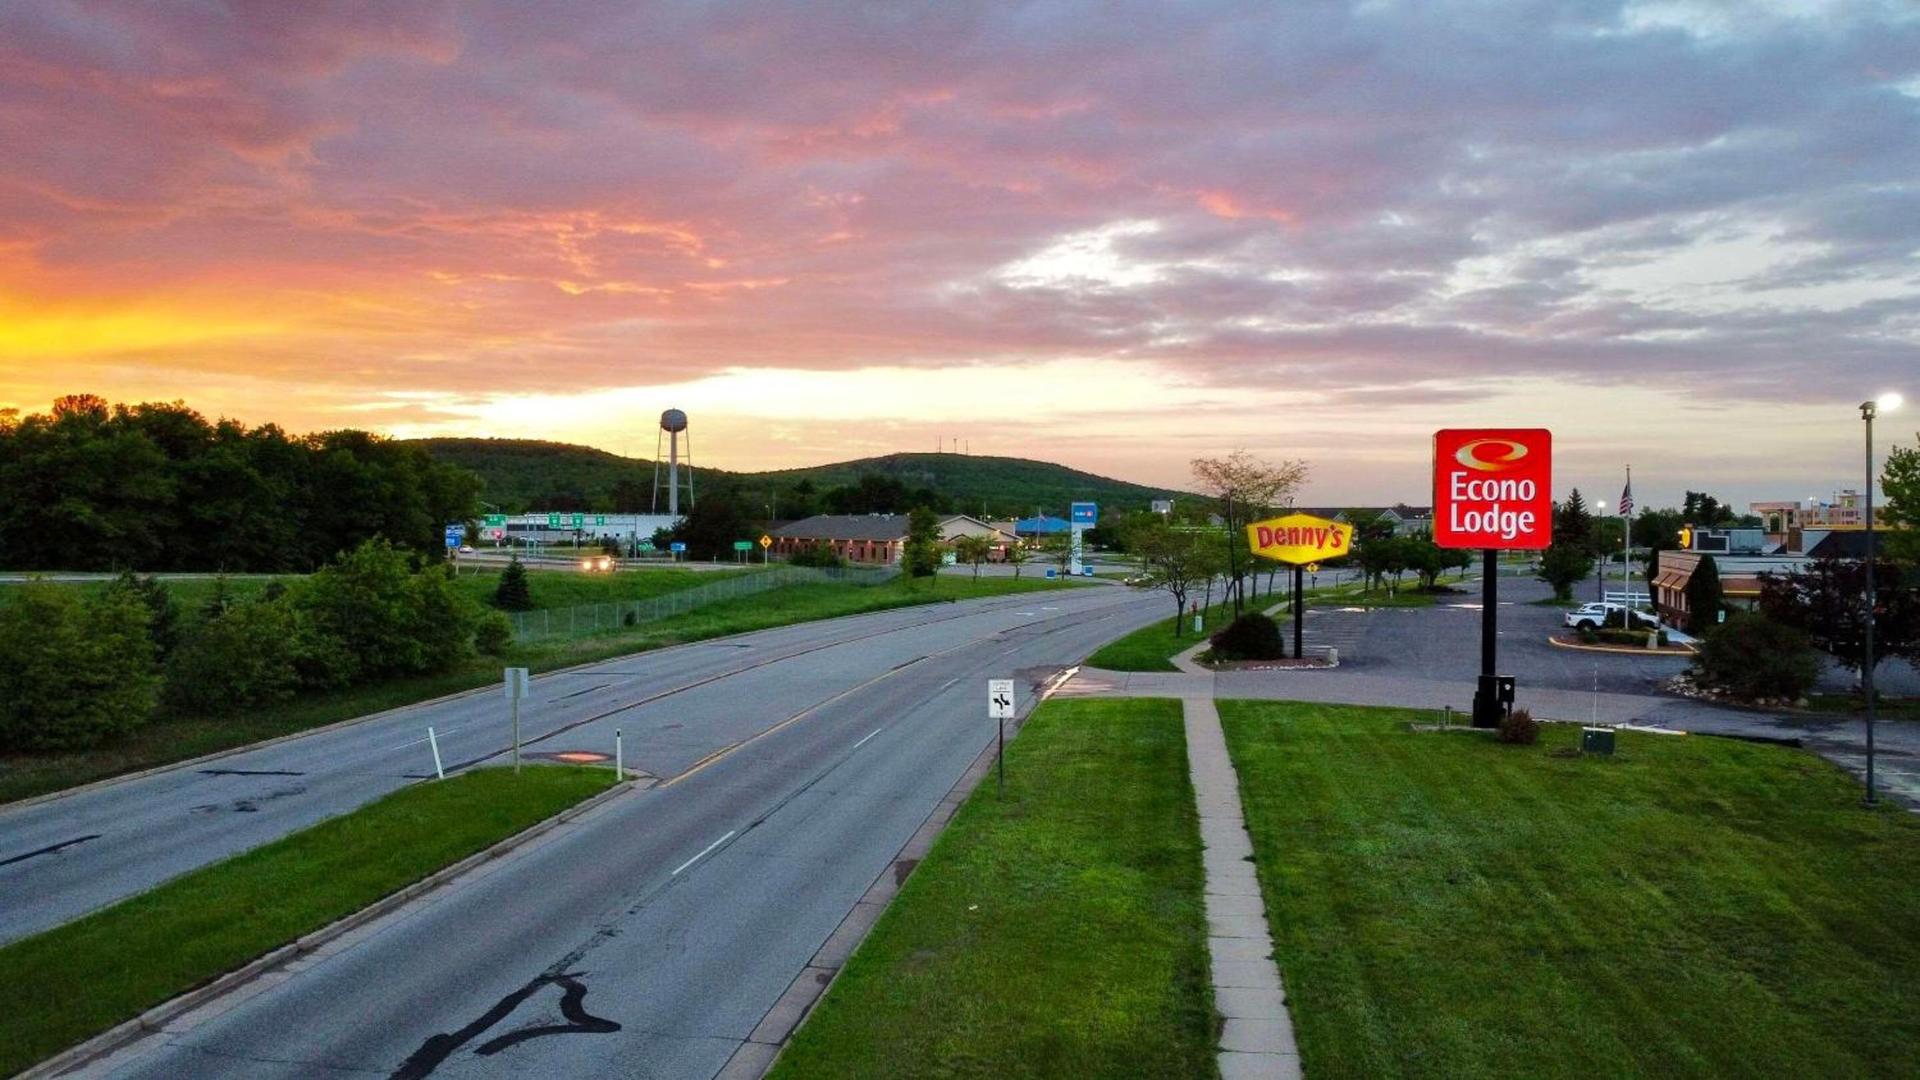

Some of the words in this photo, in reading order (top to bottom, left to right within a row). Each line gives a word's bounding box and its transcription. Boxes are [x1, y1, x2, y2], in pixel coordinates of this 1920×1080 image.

[1451, 472, 1536, 501] Econo
[1451, 503, 1535, 540] Lodge
[1257, 524, 1343, 549] Denny's
